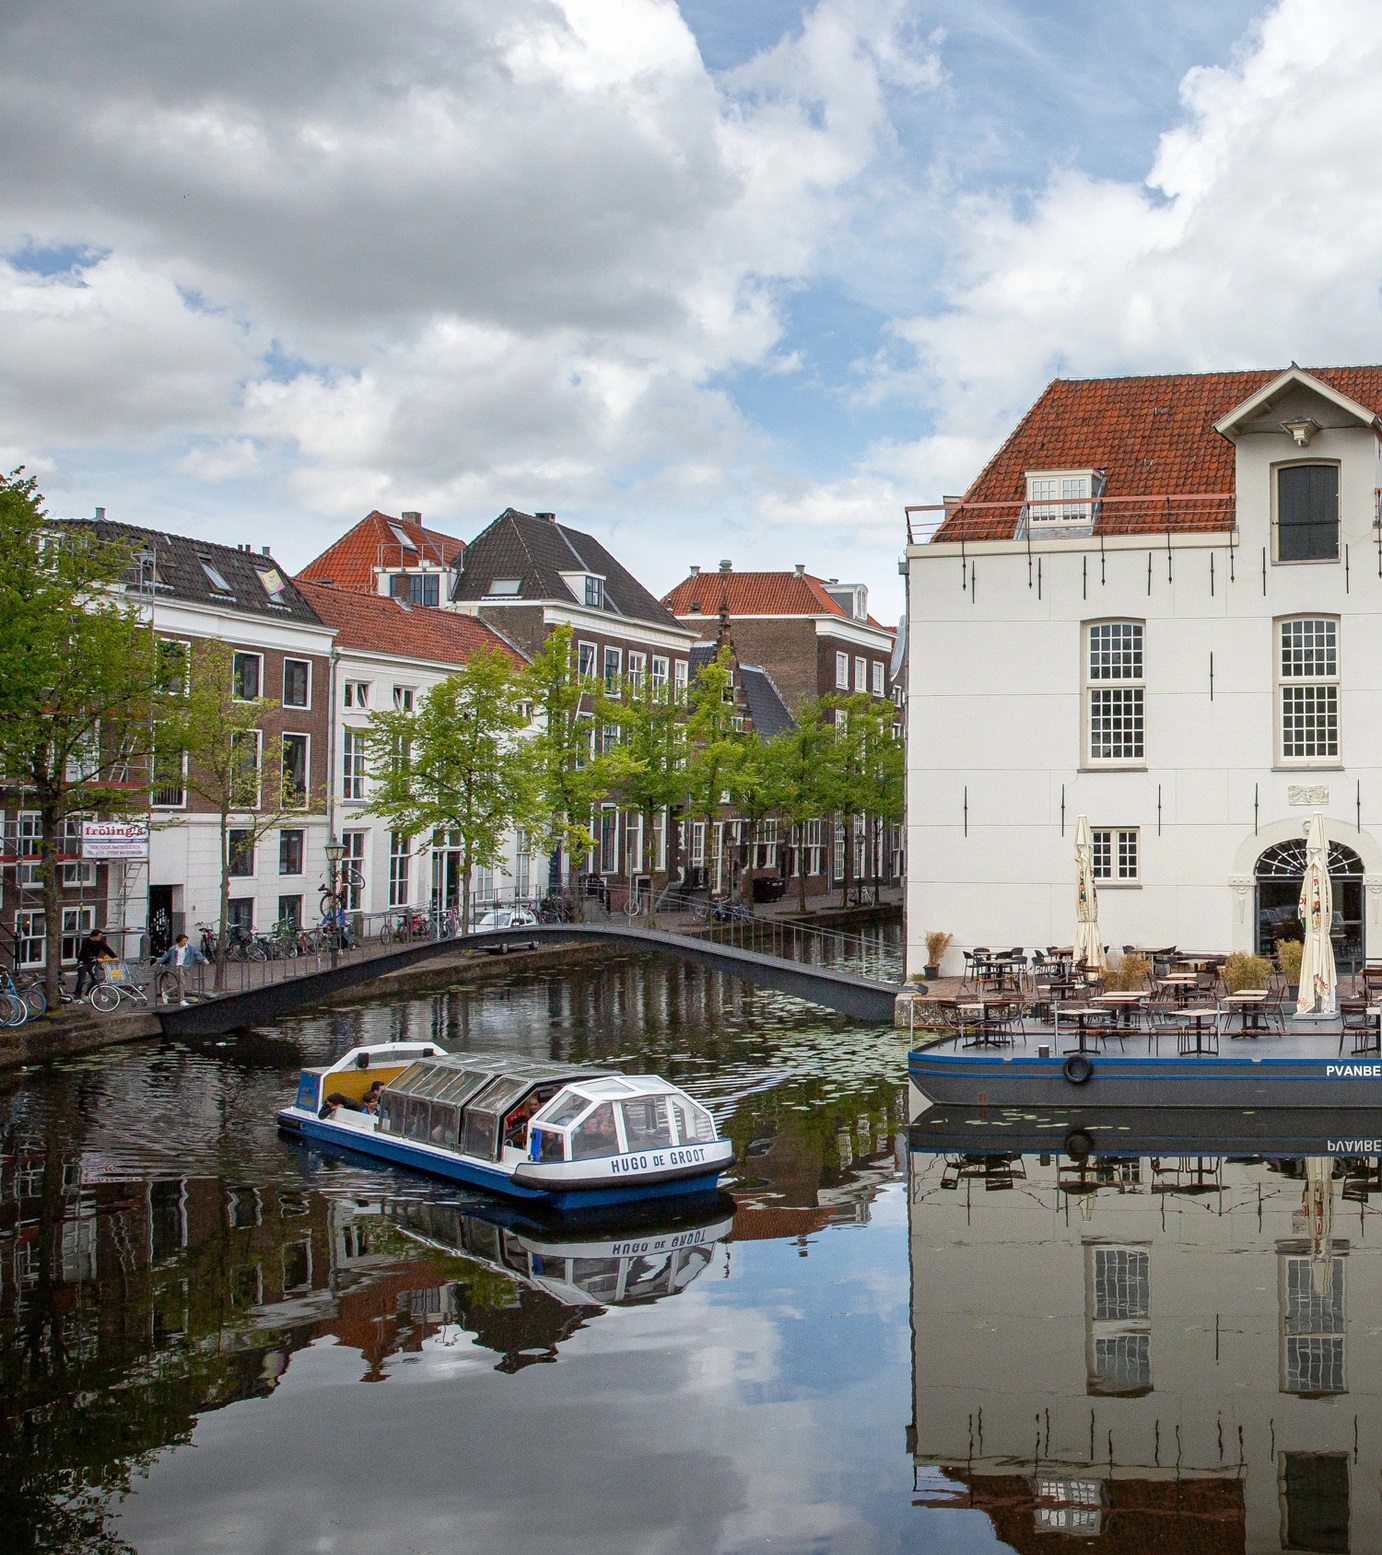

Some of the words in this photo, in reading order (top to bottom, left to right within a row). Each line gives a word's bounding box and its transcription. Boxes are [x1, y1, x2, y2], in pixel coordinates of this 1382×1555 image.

[85, 825, 145, 838] fröling's
[611, 1156, 647, 1173] HUGO
[653, 1155, 665, 1166] DE
[670, 1148, 705, 1165] GROOT
